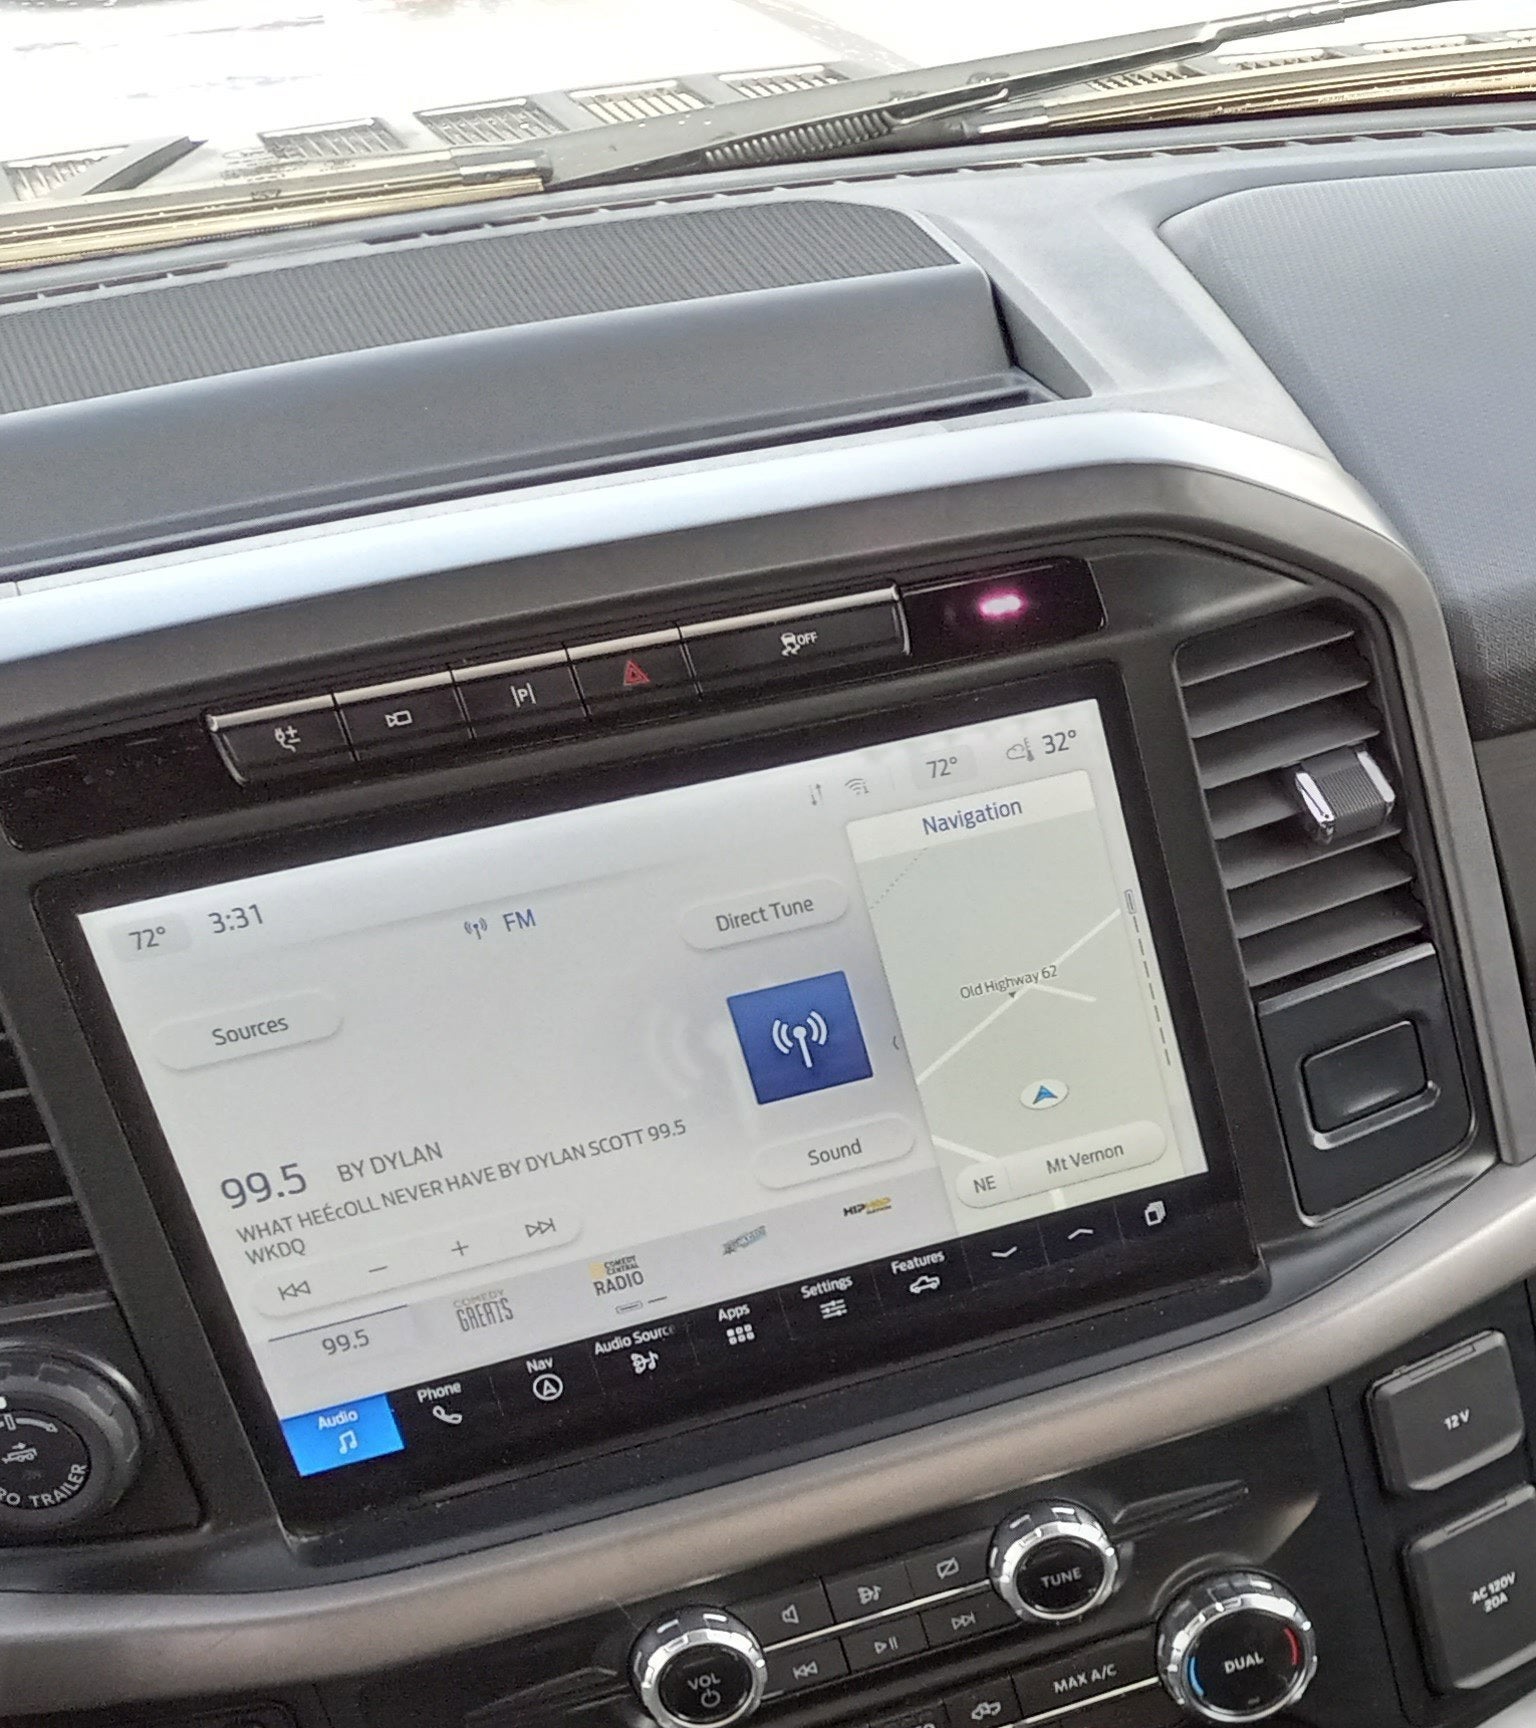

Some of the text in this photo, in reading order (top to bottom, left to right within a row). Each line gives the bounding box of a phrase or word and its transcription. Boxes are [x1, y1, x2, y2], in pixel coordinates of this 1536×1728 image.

[797, 630, 818, 646] OFF
[1042, 728, 1077, 755] 32°
[926, 756, 958, 780] 72°
[922, 799, 1023, 836] Navigation
[208, 903, 265, 935] 3:31
[503, 908, 536, 934] FM
[715, 897, 815, 933] Direct Tune
[129, 925, 166, 952] 72°
[960, 964, 1058, 1000] Old Highway 62
[211, 1013, 290, 1048] Sources
[336, 1141, 443, 1183] BY DYLAN
[808, 1137, 863, 1166] Sound
[1046, 1143, 1125, 1176] Mt Vernon
[220, 1162, 307, 1209] 99.5
[236, 1216, 300, 1243] WHAT
[381, 1180, 444, 1208] NEVER
[445, 1166, 497, 1193] HAVE
[498, 1159, 523, 1180] BY
[525, 1143, 587, 1174] DYLAN
[588, 1127, 643, 1158] SCOTT
[648, 1118, 687, 1143] 99.5
[973, 1174, 997, 1195] NE
[244, 1237, 306, 1266] WKDQ
[604, 1255, 637, 1269] COMEDY
[891, 1250, 945, 1275] Features
[593, 1270, 645, 1297] RADIO
[801, 1275, 853, 1300] Settings
[456, 1297, 514, 1333] GREATS
[718, 1303, 750, 1323] Apps
[322, 1328, 370, 1356] 99.5
[594, 1336, 633, 1356] Audio
[526, 1356, 554, 1374] Nav
[417, 1380, 462, 1403] Phone
[318, 1409, 358, 1431] Audio
[28, 1464, 88, 1508] TRAILER
[1040, 1567, 1082, 1589] TUNE
[1471, 1571, 1517, 1605] AC 120V
[1484, 1594, 1509, 1614] 20A
[1224, 1651, 1264, 1675] DUAL
[688, 1672, 722, 1691] VOL
[1054, 1663, 1118, 1694] MAX A/C
